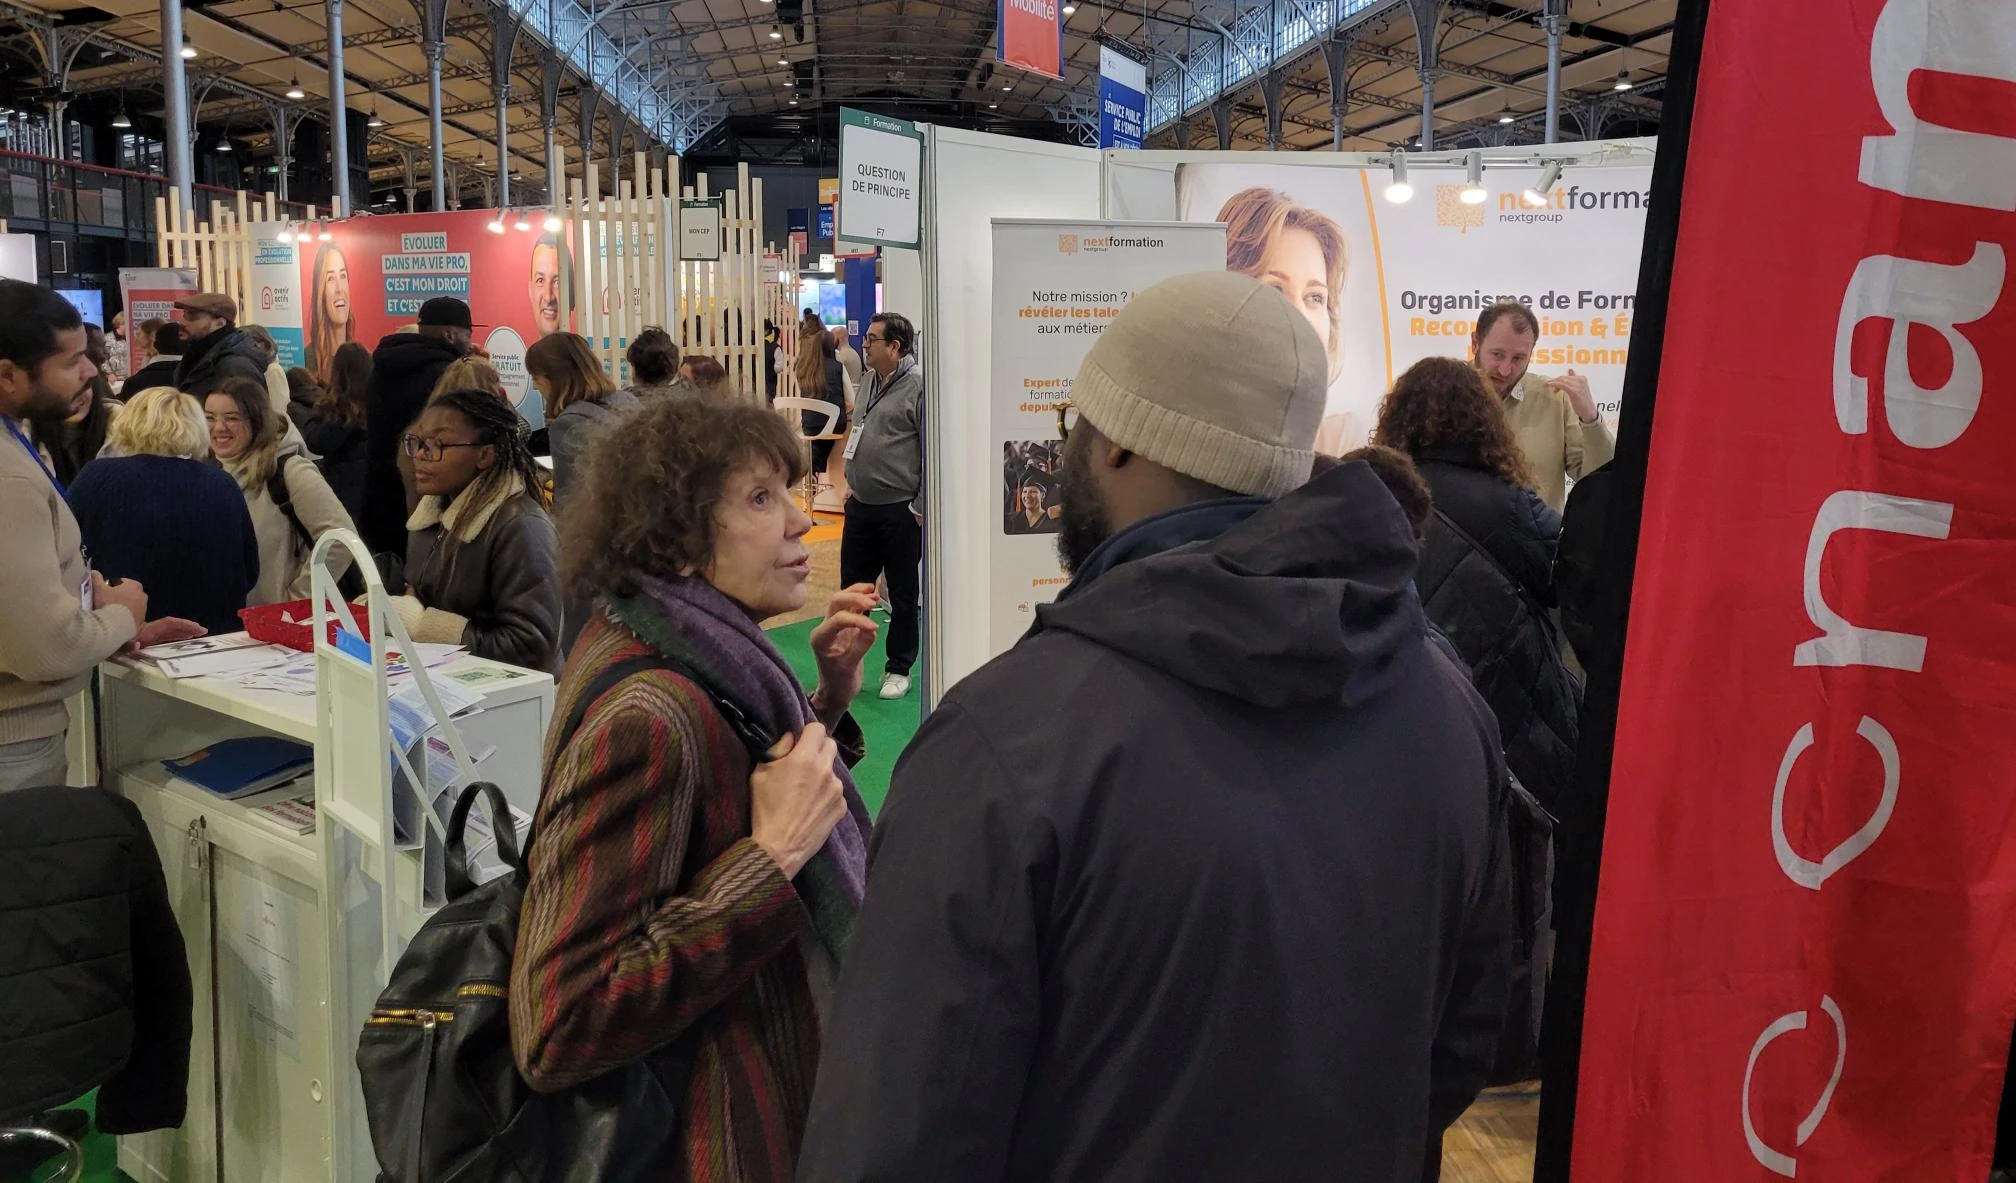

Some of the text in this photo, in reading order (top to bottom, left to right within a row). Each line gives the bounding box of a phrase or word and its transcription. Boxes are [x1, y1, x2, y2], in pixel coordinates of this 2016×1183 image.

[1104, 99, 1141, 125] SERVICE PUBLIC
[873, 118, 902, 132] Formation
[1113, 118, 1121, 131] DE
[857, 163, 906, 182] QUESTION
[852, 180, 910, 200] DE PRINCIPE
[1499, 185, 1651, 211] netforma
[1499, 213, 1563, 224] nextgroup
[876, 227, 885, 238] F7
[403, 234, 446, 250] ÉVOLUER
[1083, 235, 1164, 248] nextformation
[385, 255, 468, 271] DANS MA VIE PRO,
[386, 277, 468, 292] C'EST MON DROIT
[1032, 290, 1128, 302] Notre mission ?
[1540, 290, 1571, 309] de
[387, 299, 399, 312] ET
[1018, 305, 1068, 318] révéler
[1070, 306, 1091, 318] les
[1037, 324, 1061, 334] aux
[1590, 317, 1608, 338] &
[1023, 378, 1060, 389] Expert
[1020, 402, 1055, 413] depui
